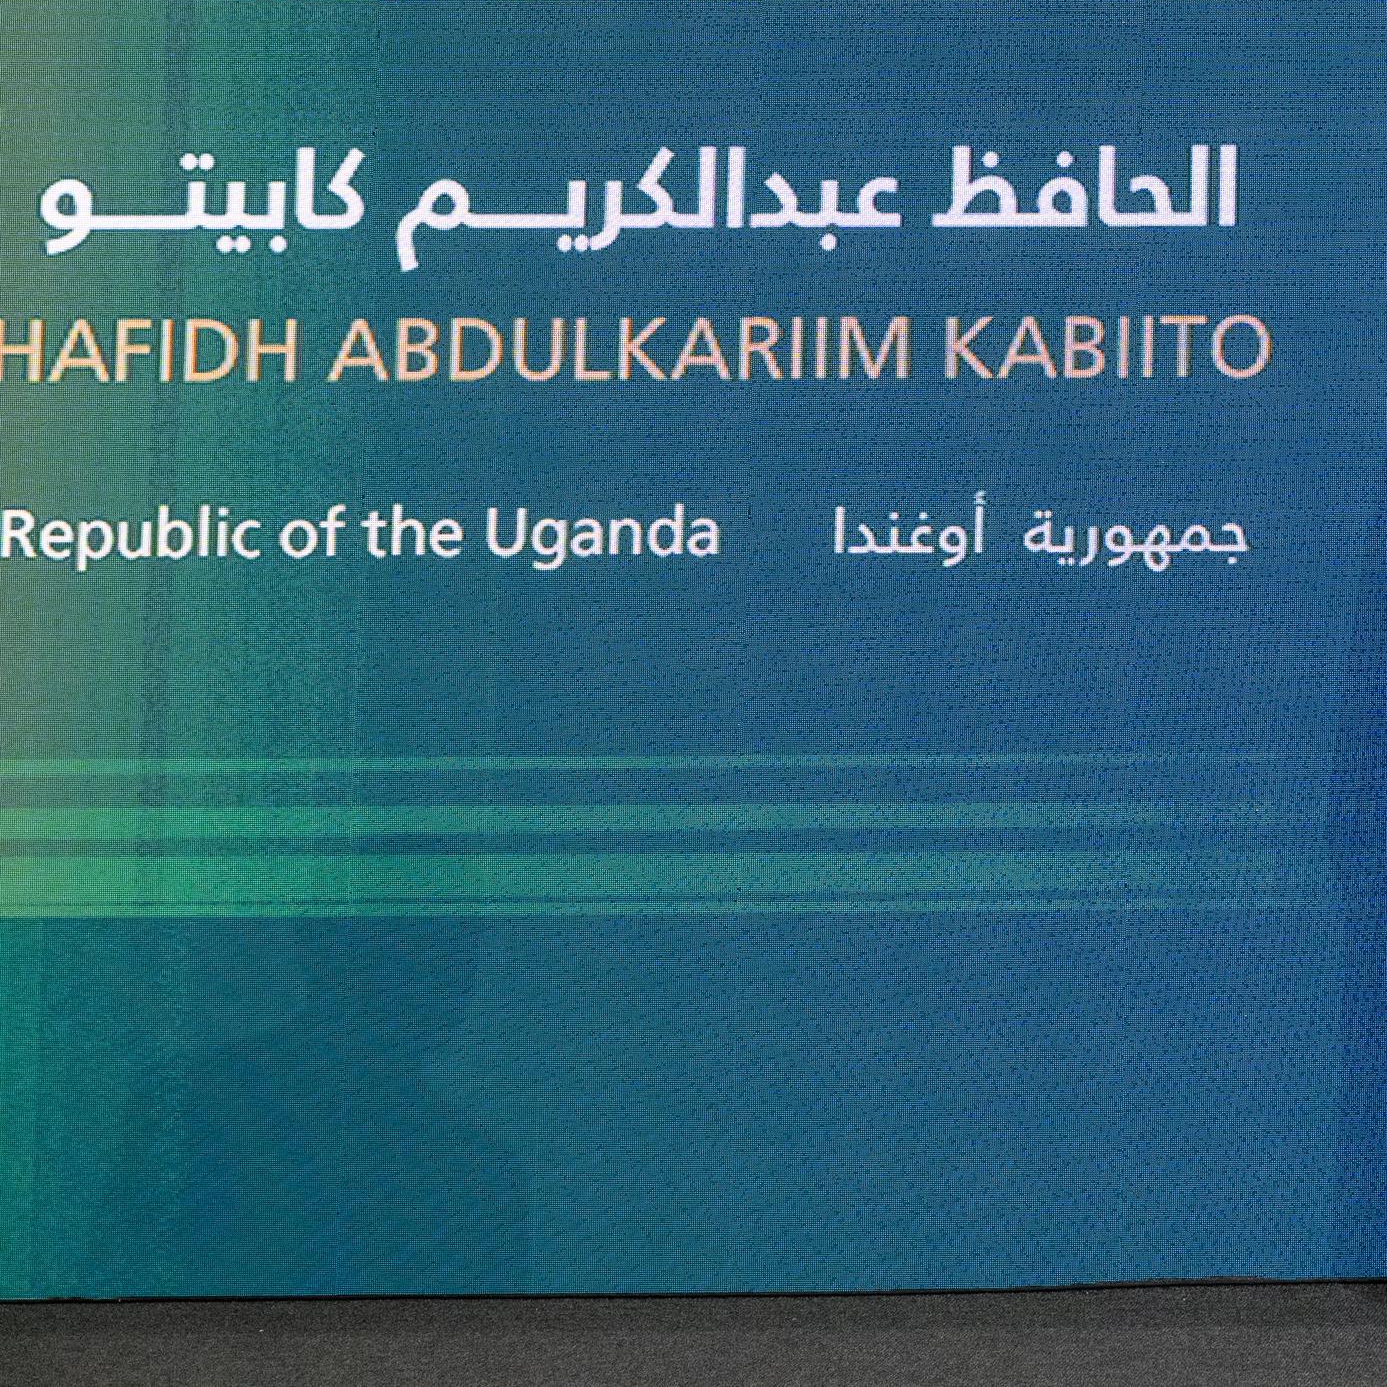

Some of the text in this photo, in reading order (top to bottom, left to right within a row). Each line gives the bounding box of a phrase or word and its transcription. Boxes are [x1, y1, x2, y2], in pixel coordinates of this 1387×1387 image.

[932, 144, 1238, 227] الحافظ
[0, 314, 1273, 383] HAFIDH ABDULKARIIM KABIITO
[0, 503, 719, 572] Republic of the Uganda
[834, 493, 1248, 572] جمهورية أوغندا
